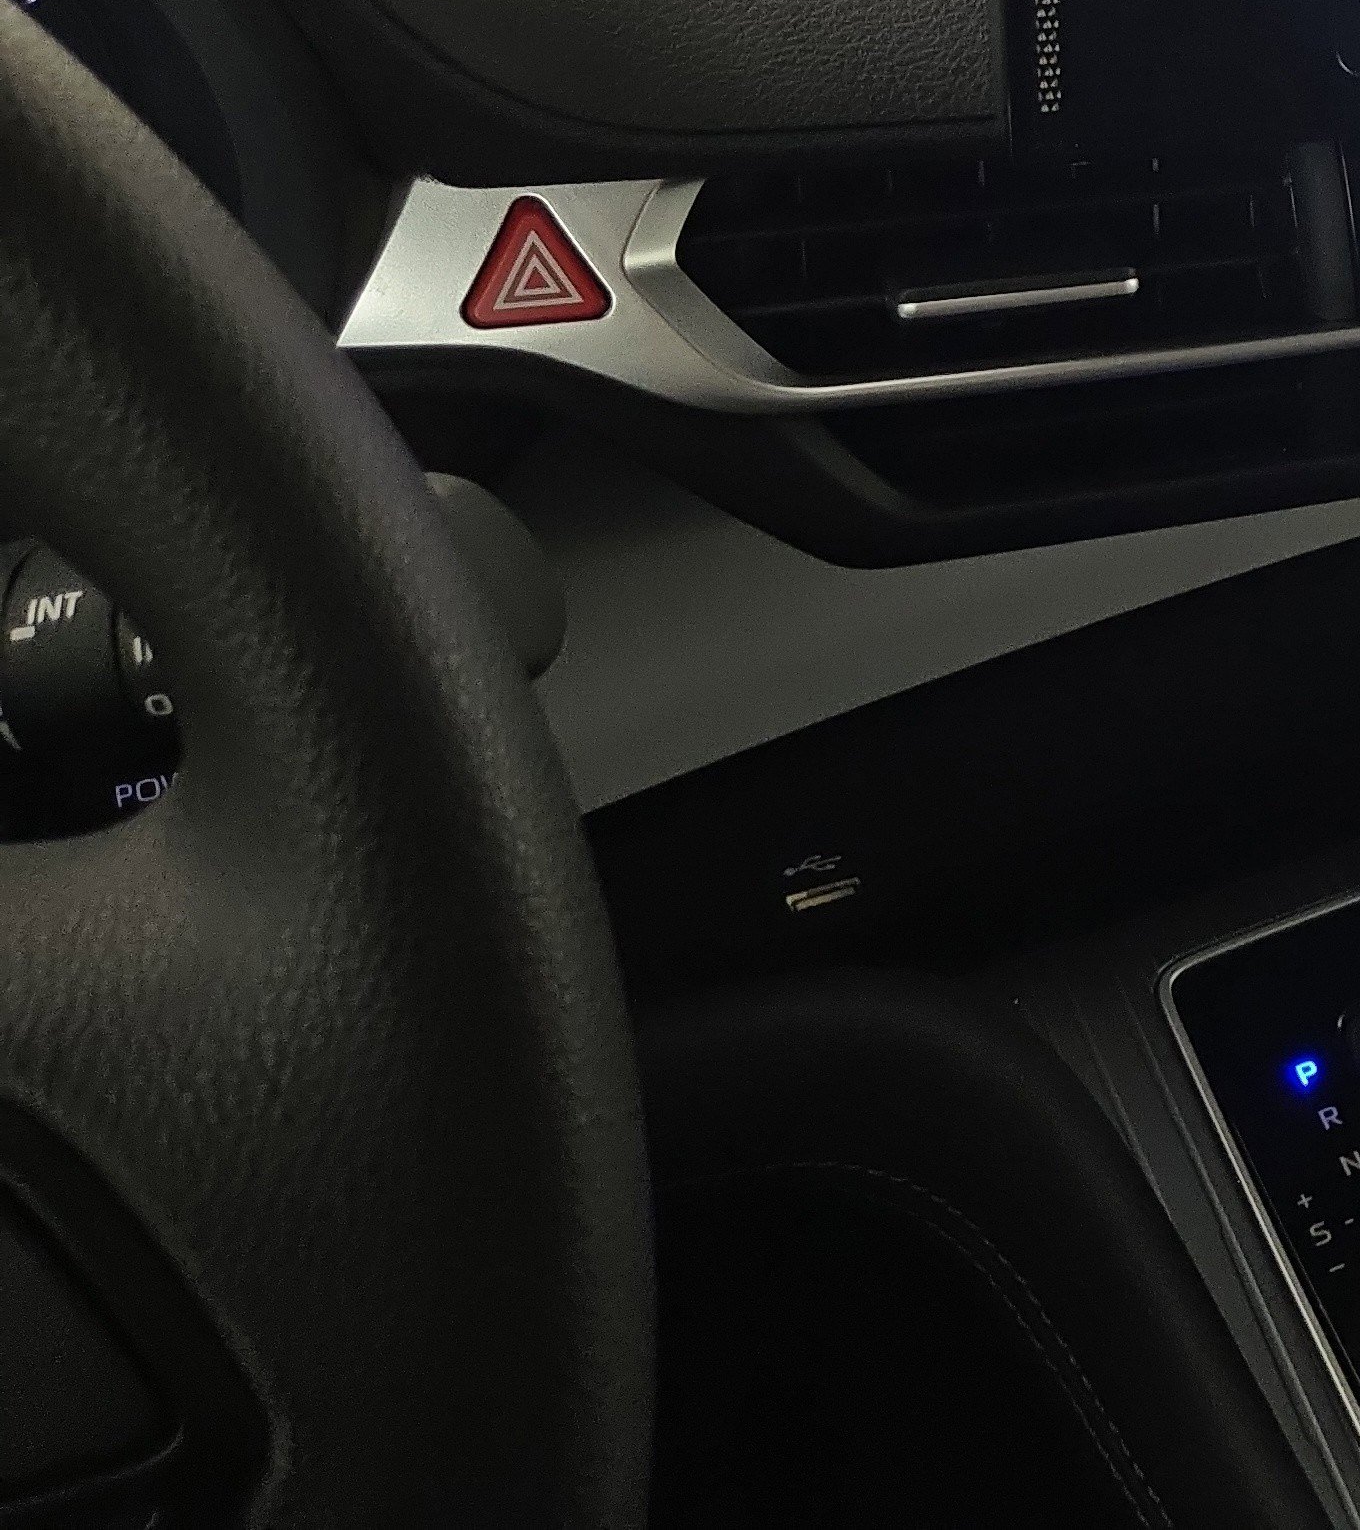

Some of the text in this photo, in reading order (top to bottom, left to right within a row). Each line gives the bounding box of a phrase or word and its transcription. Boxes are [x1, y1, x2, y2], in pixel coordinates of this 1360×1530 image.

[26, 590, 83, 625] INT
[1295, 1060, 1318, 1087] P
[1317, 1106, 1343, 1131] R
